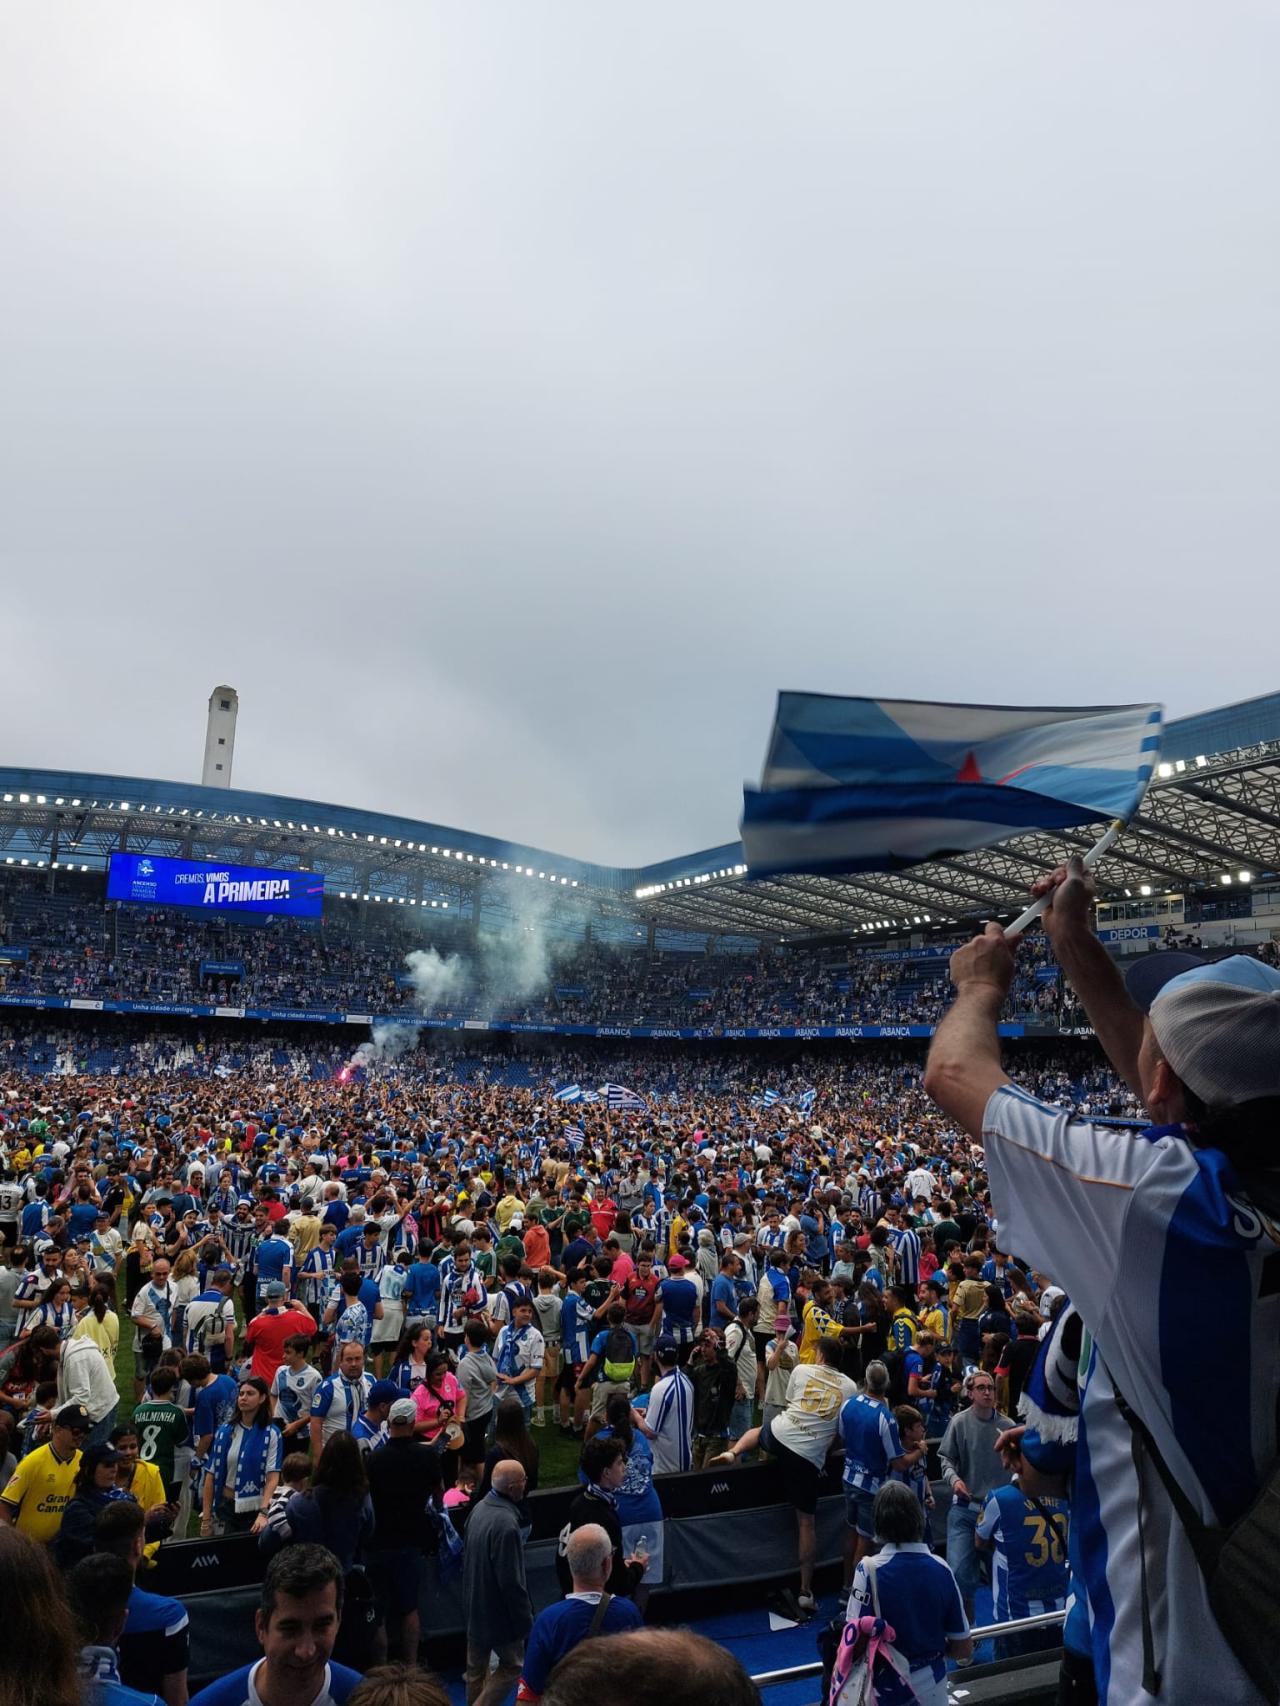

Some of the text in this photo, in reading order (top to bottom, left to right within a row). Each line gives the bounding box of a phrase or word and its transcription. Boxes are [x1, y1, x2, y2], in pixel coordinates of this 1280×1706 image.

[202, 879, 290, 904] A PRIMEIRA
[1110, 928, 1148, 941] DEPOR
[134, 1411, 176, 1424] DJALMINHA
[140, 1424, 161, 1461] 8
[46, 1494, 70, 1503] Gran
[36, 1503, 65, 1513] Cana
